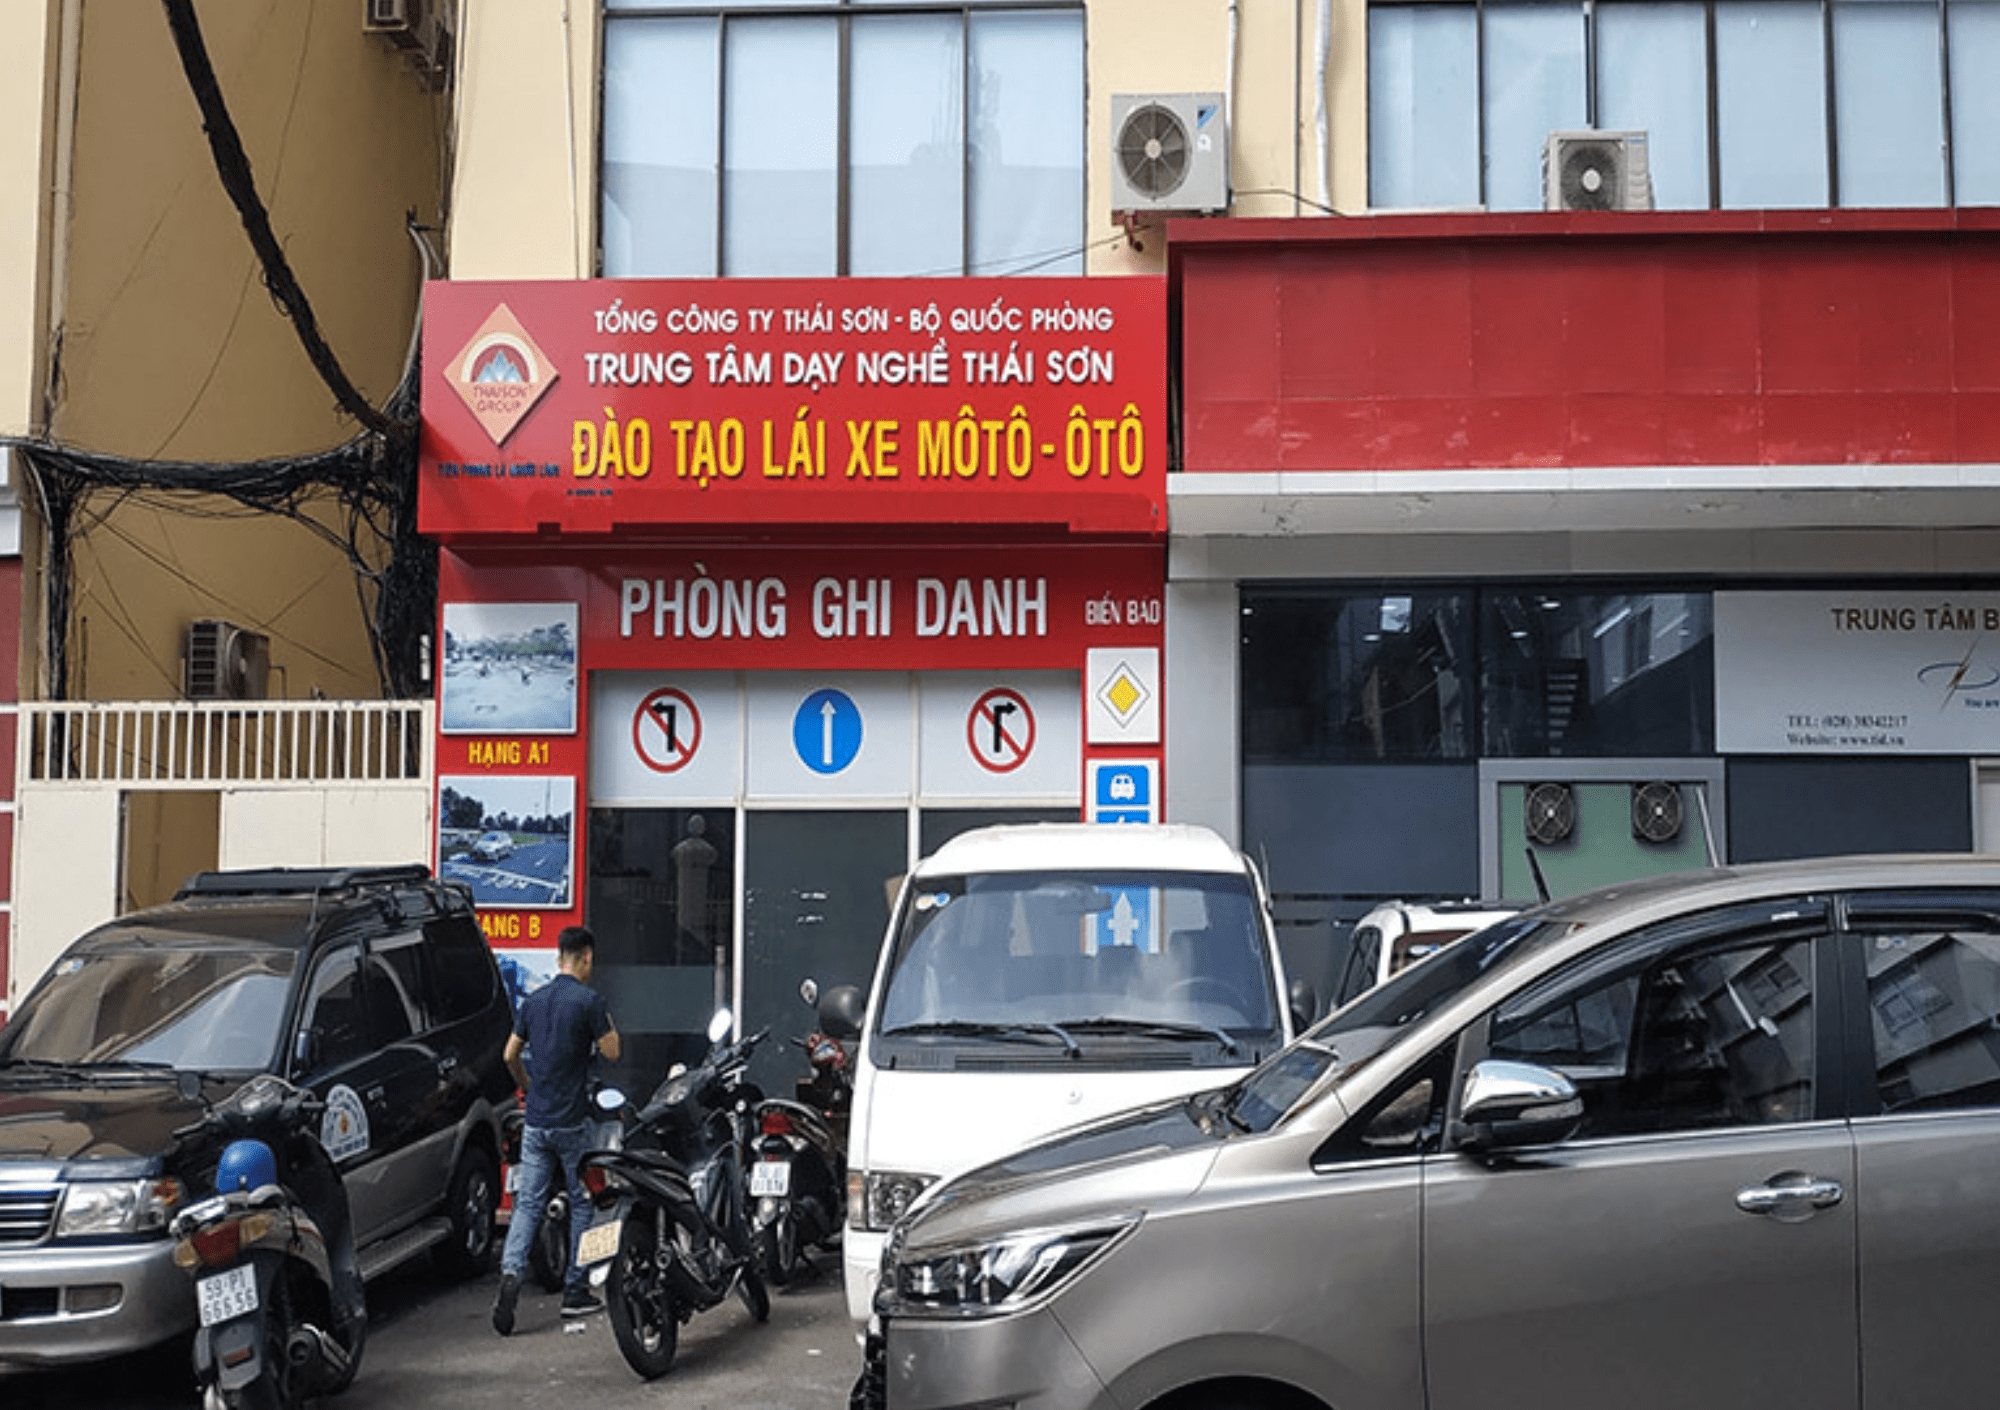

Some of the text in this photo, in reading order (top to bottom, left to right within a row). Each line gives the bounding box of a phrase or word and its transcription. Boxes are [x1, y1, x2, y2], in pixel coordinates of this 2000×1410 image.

[594, 298, 659, 333] TỔNG
[666, 303, 740, 333] CÔNG
[748, 309, 775, 333] TY
[783, 301, 834, 333] THÁI
[841, 305, 889, 333] SƠN
[909, 303, 942, 338] BỘ
[950, 296, 1023, 332] QUỐC
[1030, 300, 1114, 332] PHÒNG
[584, 337, 1114, 392] TRUNG TÂM DẠY NGHỀ THÁI SƠN
[477, 399, 522, 413] GROUP
[571, 404, 651, 477] ĐÀO
[669, 417, 745, 488] TẠO
[762, 404, 826, 477] LÁI
[845, 420, 899, 477] XE
[917, 403, 1033, 478] MÔTÔ
[1065, 402, 1145, 478] ÔTÔ
[619, 562, 1047, 638] PHÒNG GHI DANH
[1831, 608, 1916, 631] TRUNG
[1923, 603, 1976, 631] TÂM
[1787, 714, 1819, 727] TEL:
[1787, 732, 1837, 746] Website:
[468, 741, 550, 769] HẠNG A1
[477, 913, 542, 939] ANG B
